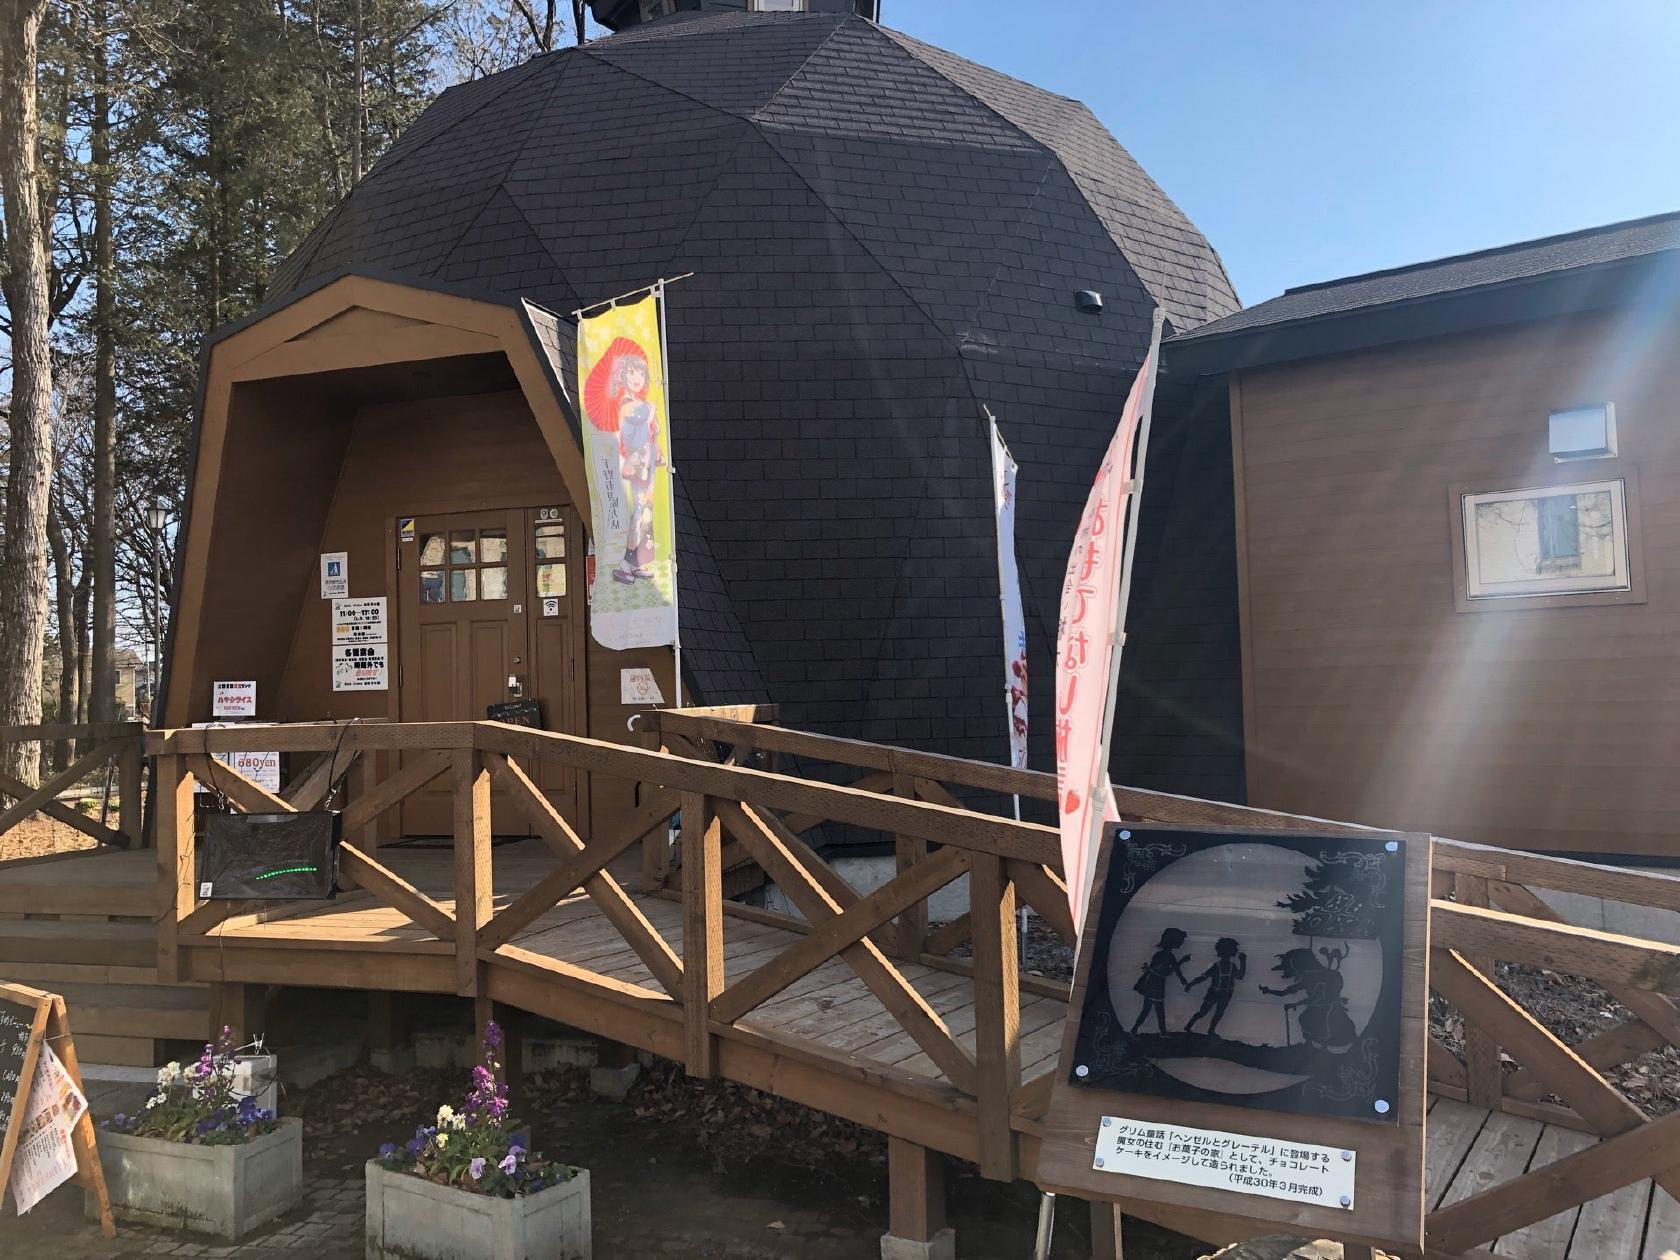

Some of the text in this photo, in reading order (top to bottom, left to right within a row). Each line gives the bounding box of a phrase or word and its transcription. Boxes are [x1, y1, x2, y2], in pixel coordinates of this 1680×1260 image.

[217, 696, 252, 704] ハヤシライス
[1115, 1145, 1273, 1177] ケーキをイメージして造られました。
